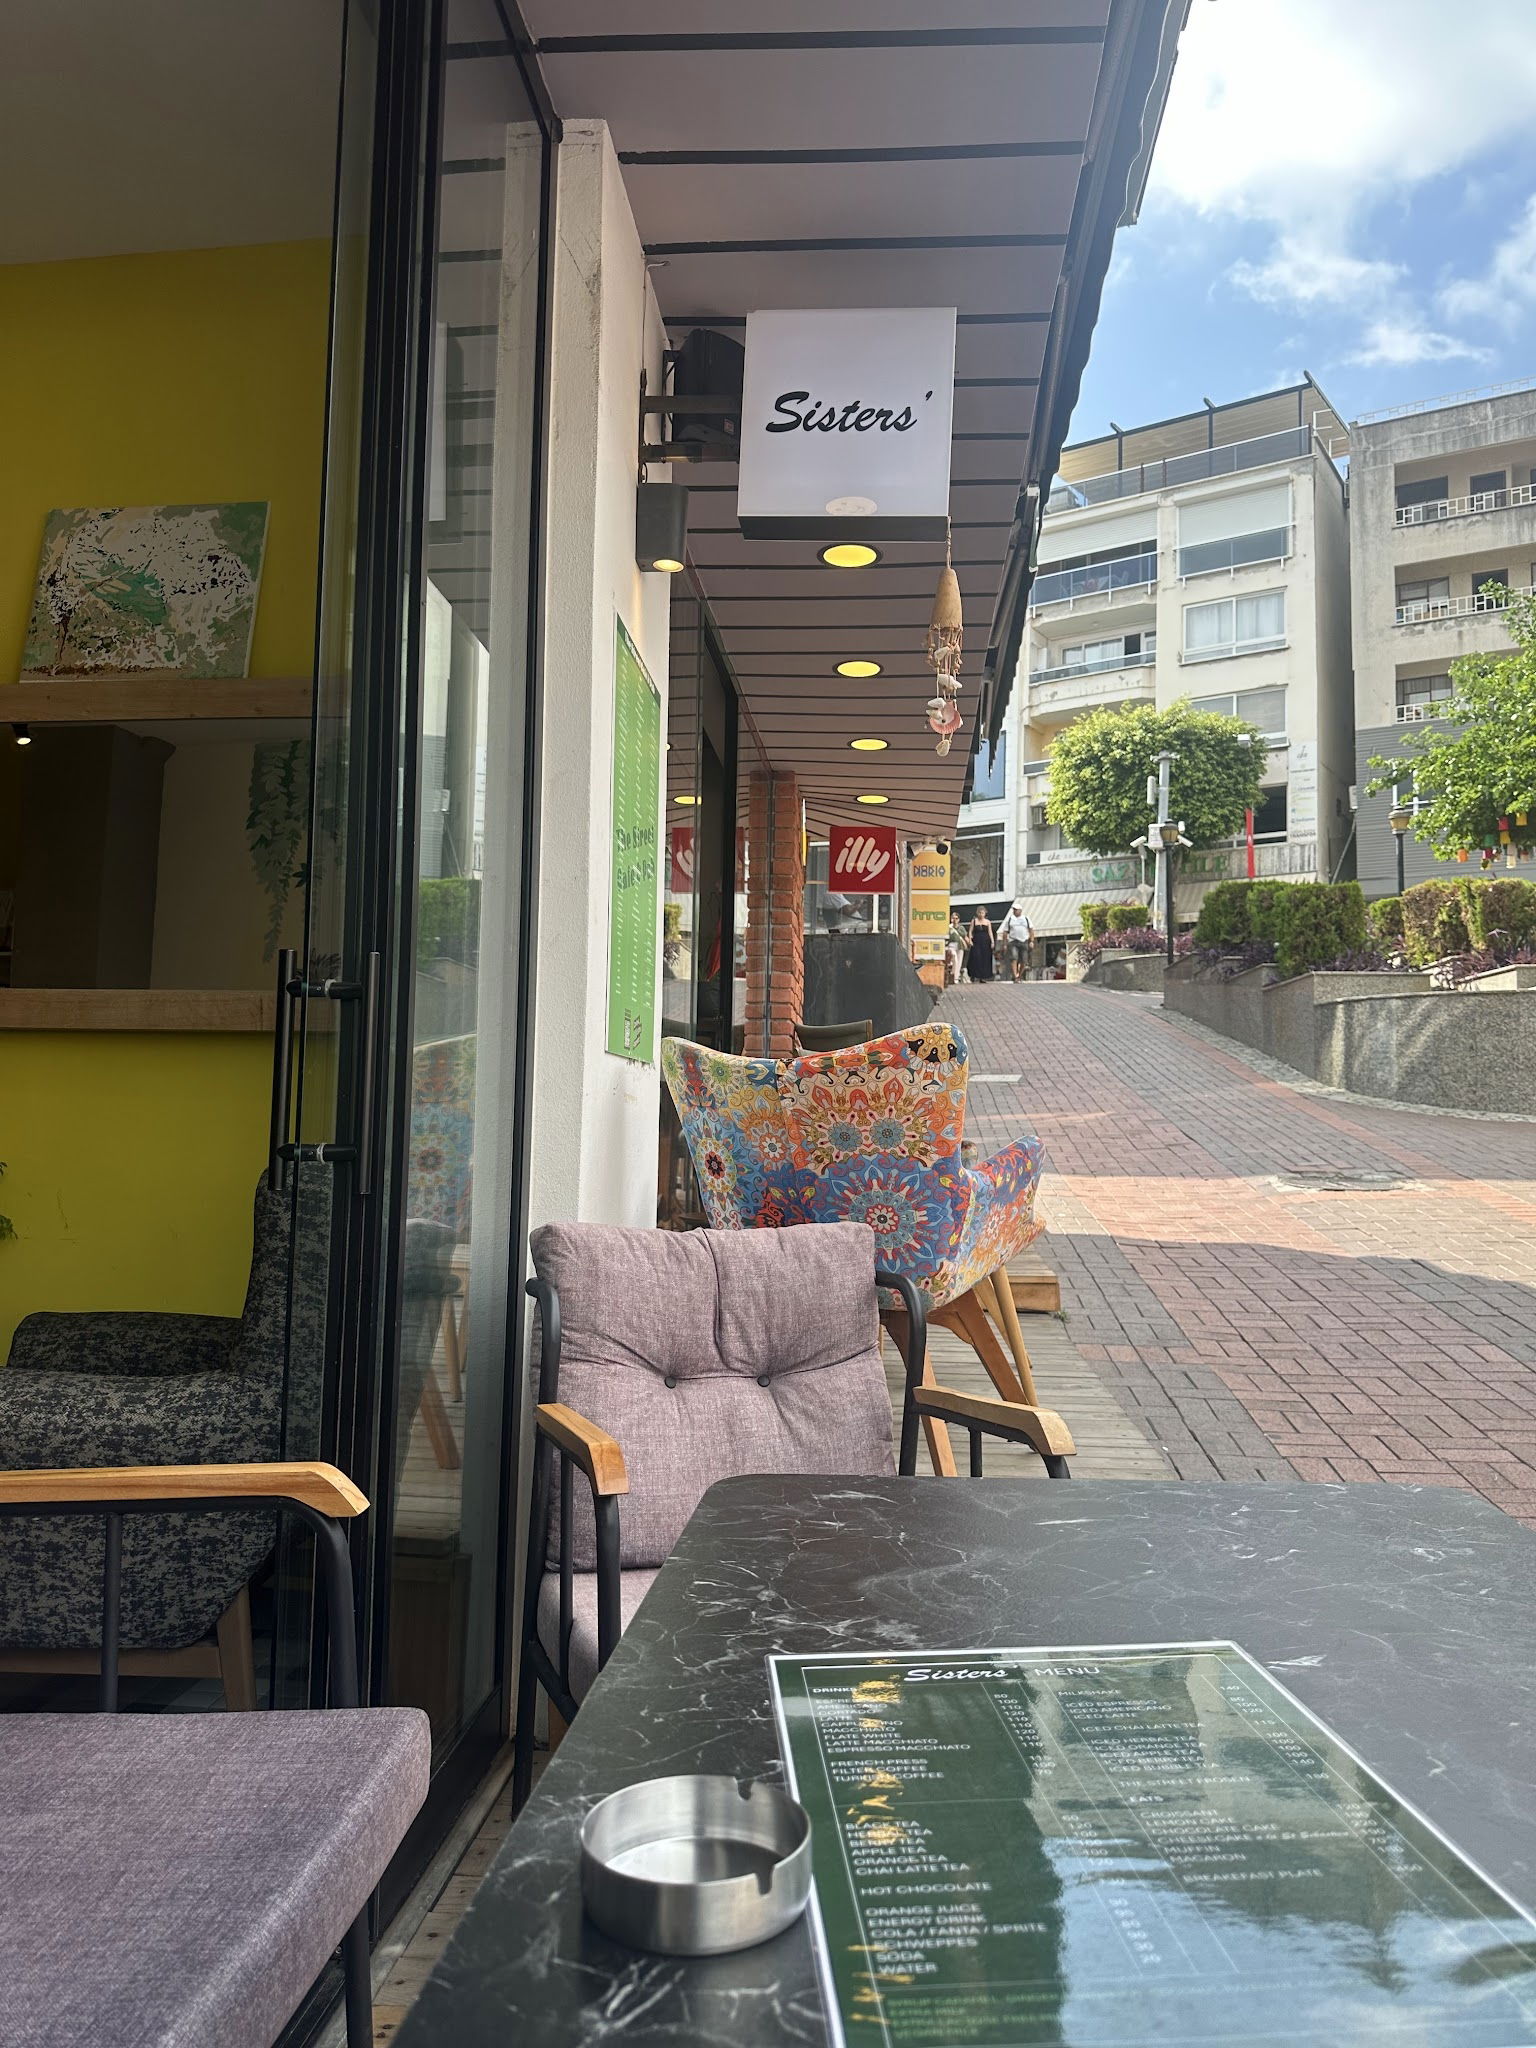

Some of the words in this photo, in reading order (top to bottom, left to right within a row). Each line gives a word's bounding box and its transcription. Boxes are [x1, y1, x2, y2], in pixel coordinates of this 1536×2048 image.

[766, 390, 933, 433] Sisters'
[834, 835, 891, 883] illy
[1034, 1667, 1100, 1678] MENU
[1096, 1699, 1158, 1707] ESPRESSO
[1101, 1705, 1172, 1713] AMERICANO
[823, 1726, 896, 1734] MACCHIATO
[824, 1733, 860, 1741] FLATE
[863, 1738, 938, 1746] MACCHIATO
[827, 1745, 896, 1754] ESPRESSO
[896, 1743, 971, 1752] MACCHIATO
[1175, 1748, 1199, 1756] TEA
[831, 1760, 880, 1768] FRENCH
[881, 1758, 928, 1766] PRESS
[832, 1767, 876, 1775] FILTER
[876, 1765, 928, 1773] COFFEE
[894, 1772, 945, 1780] COFFEE
[1129, 1795, 1164, 1803] EATS
[1140, 1808, 1218, 1818] CROISSANT
[845, 1822, 894, 1830] BLACK
[895, 1820, 920, 1828] TEA
[1146, 1818, 1198, 1827] LEMON
[1199, 1816, 1234, 1825] CAKE
[907, 1828, 933, 1836] TEA
[1151, 1824, 1240, 1835] CHOCOLATE
[1242, 1822, 1279, 1832] CAKE
[899, 1837, 926, 1846] TEA
[1157, 1833, 1252, 1845] CHEESECAKE
[851, 1848, 897, 1857] APPLE
[900, 1846, 927, 1854] TEA
[1163, 1844, 1220, 1854] MUFFIN
[853, 1856, 916, 1866] ORANGE
[921, 1854, 948, 1862] TEA
[1169, 1853, 1247, 1864] MACARON
[856, 1867, 894, 1876] CHAI
[897, 1864, 941, 1874] LATTE
[943, 1862, 971, 1872] TEA
[1277, 1867, 1325, 1878] PLATE
[861, 1886, 893, 1897] HOT
[895, 1881, 993, 1894] CHOCOLATE
[865, 1905, 935, 1917] ORANGE
[936, 1903, 982, 1914] JUICE
[867, 1916, 933, 1928] ENERGY
[935, 1914, 988, 1925] DRINK
[871, 1928, 917, 1939] COLA
[928, 1926, 982, 1937] FANTA
[992, 1922, 1049, 1934] SPRITE
[874, 1938, 979, 1951] SCHWEPPES
[876, 1950, 926, 1963] SODA
[878, 1962, 940, 1975] WATER
